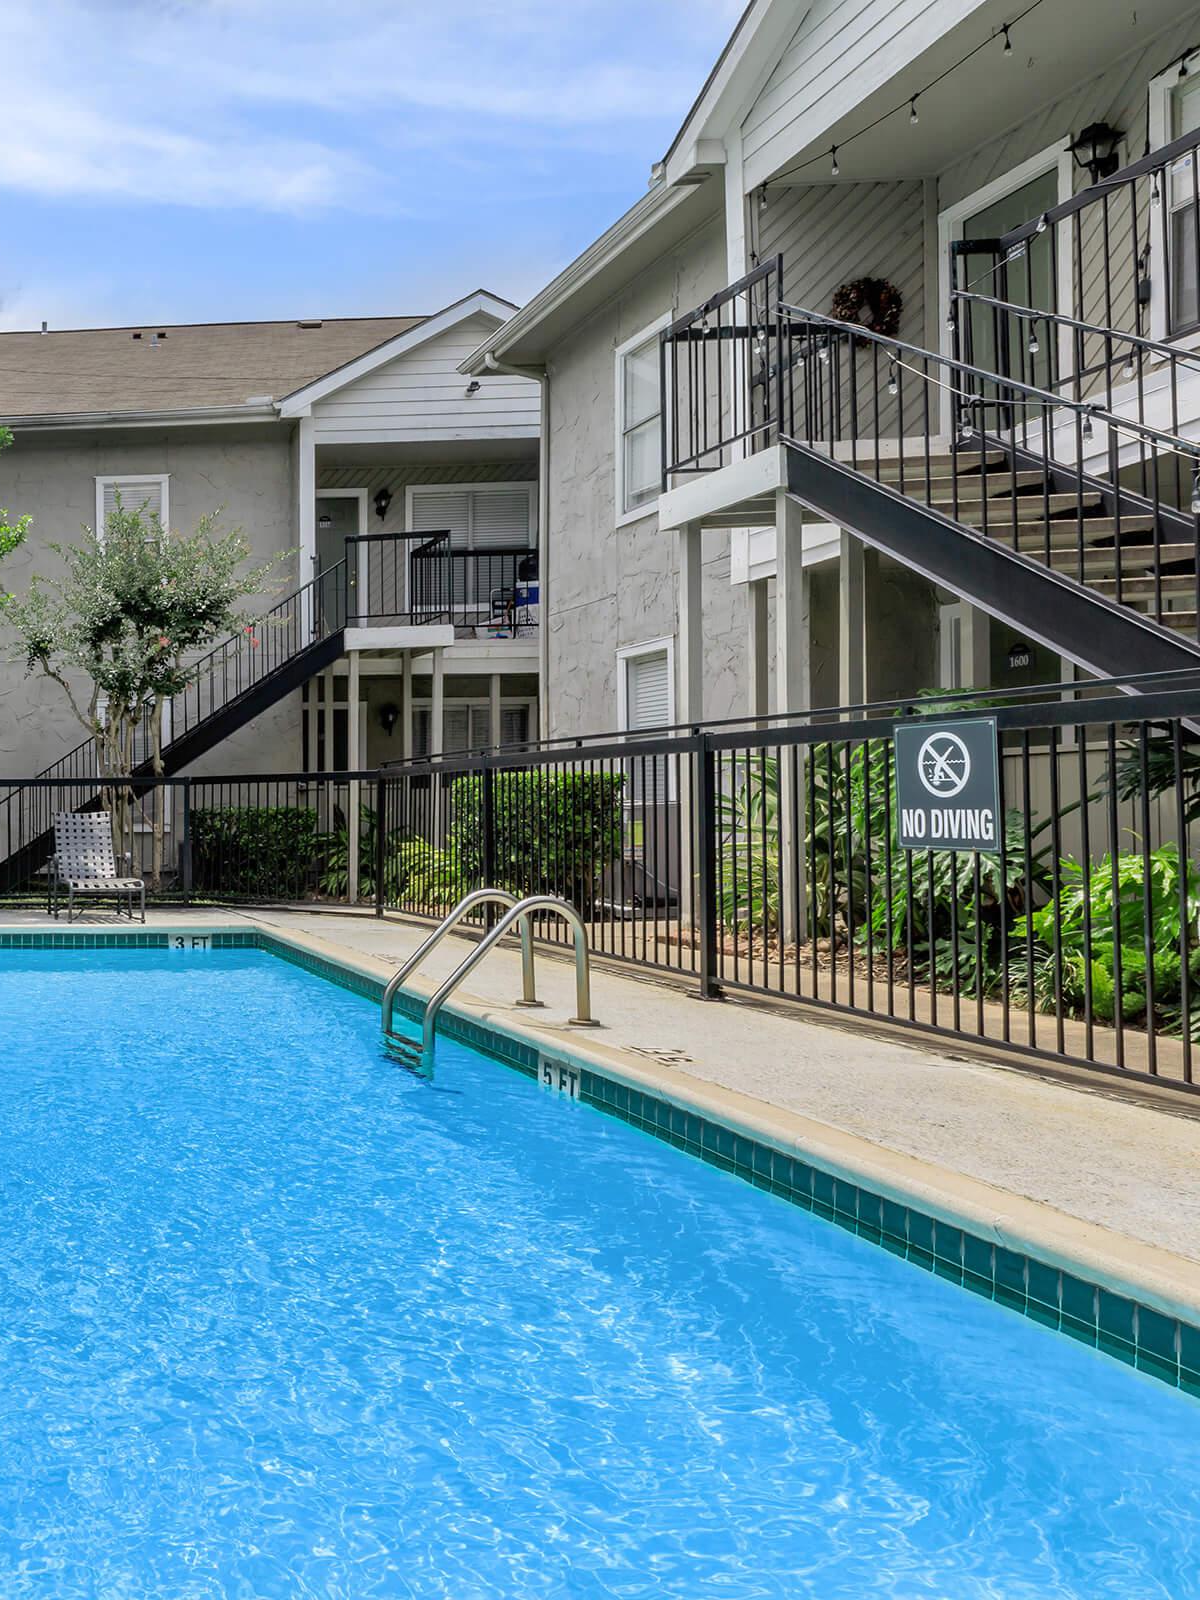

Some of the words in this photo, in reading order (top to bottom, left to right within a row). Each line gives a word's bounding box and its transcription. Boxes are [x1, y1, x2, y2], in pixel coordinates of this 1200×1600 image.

[1009, 655, 1029, 668] 1600
[902, 809, 926, 838] NO
[931, 809, 994, 840] DIVING
[175, 936, 184, 949] 3
[192, 936, 208, 949] FT
[543, 1062, 552, 1085] 5
[559, 1067, 577, 1097] FT
